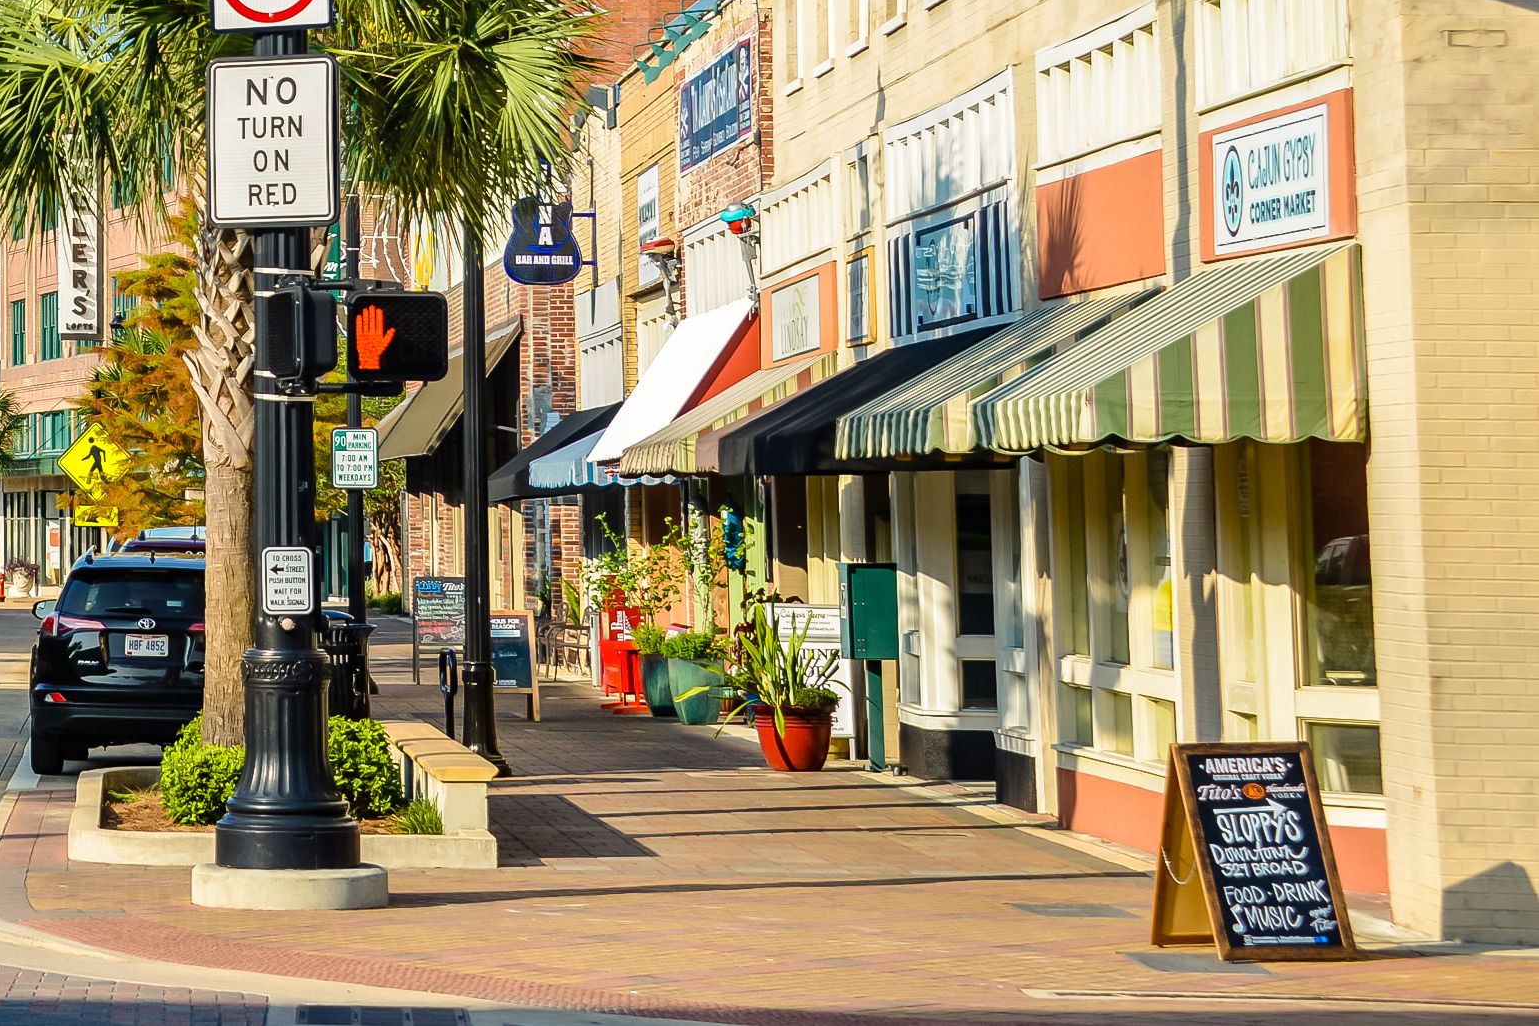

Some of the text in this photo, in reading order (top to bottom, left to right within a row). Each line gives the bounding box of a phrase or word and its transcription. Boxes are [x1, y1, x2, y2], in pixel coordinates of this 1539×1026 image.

[245, 76, 298, 107] NO
[237, 114, 303, 140] TURN
[253, 148, 290, 173] ON
[1247, 133, 1316, 190] CAJUN GYPSY
[248, 182, 297, 207] RED
[1249, 189, 1316, 224] CORNER MARKET
[515, 255, 574, 265] BAR AND GRILL
[65, 322, 93, 331] LOFTS
[334, 435, 346, 447] 90
[347, 442, 372, 450] PARKING
[352, 433, 367, 441] MIN
[341, 454, 368, 462] 7:00 AM
[337, 464, 373, 472] TO 7:00 PM
[337, 473, 372, 482] WEEKDAYS
[272, 554, 302, 562] TO CROSS
[1205, 756, 1287, 774] AMERICA'S
[1197, 783, 1243, 801] Tito's
[1271, 792, 1302, 800] VODKA
[1216, 810, 1305, 845] SLOPPY'S
[1251, 860, 1309, 878] BROAD
[1223, 879, 1331, 906] FOOD DRINK
[1244, 905, 1304, 932] MUSIC
